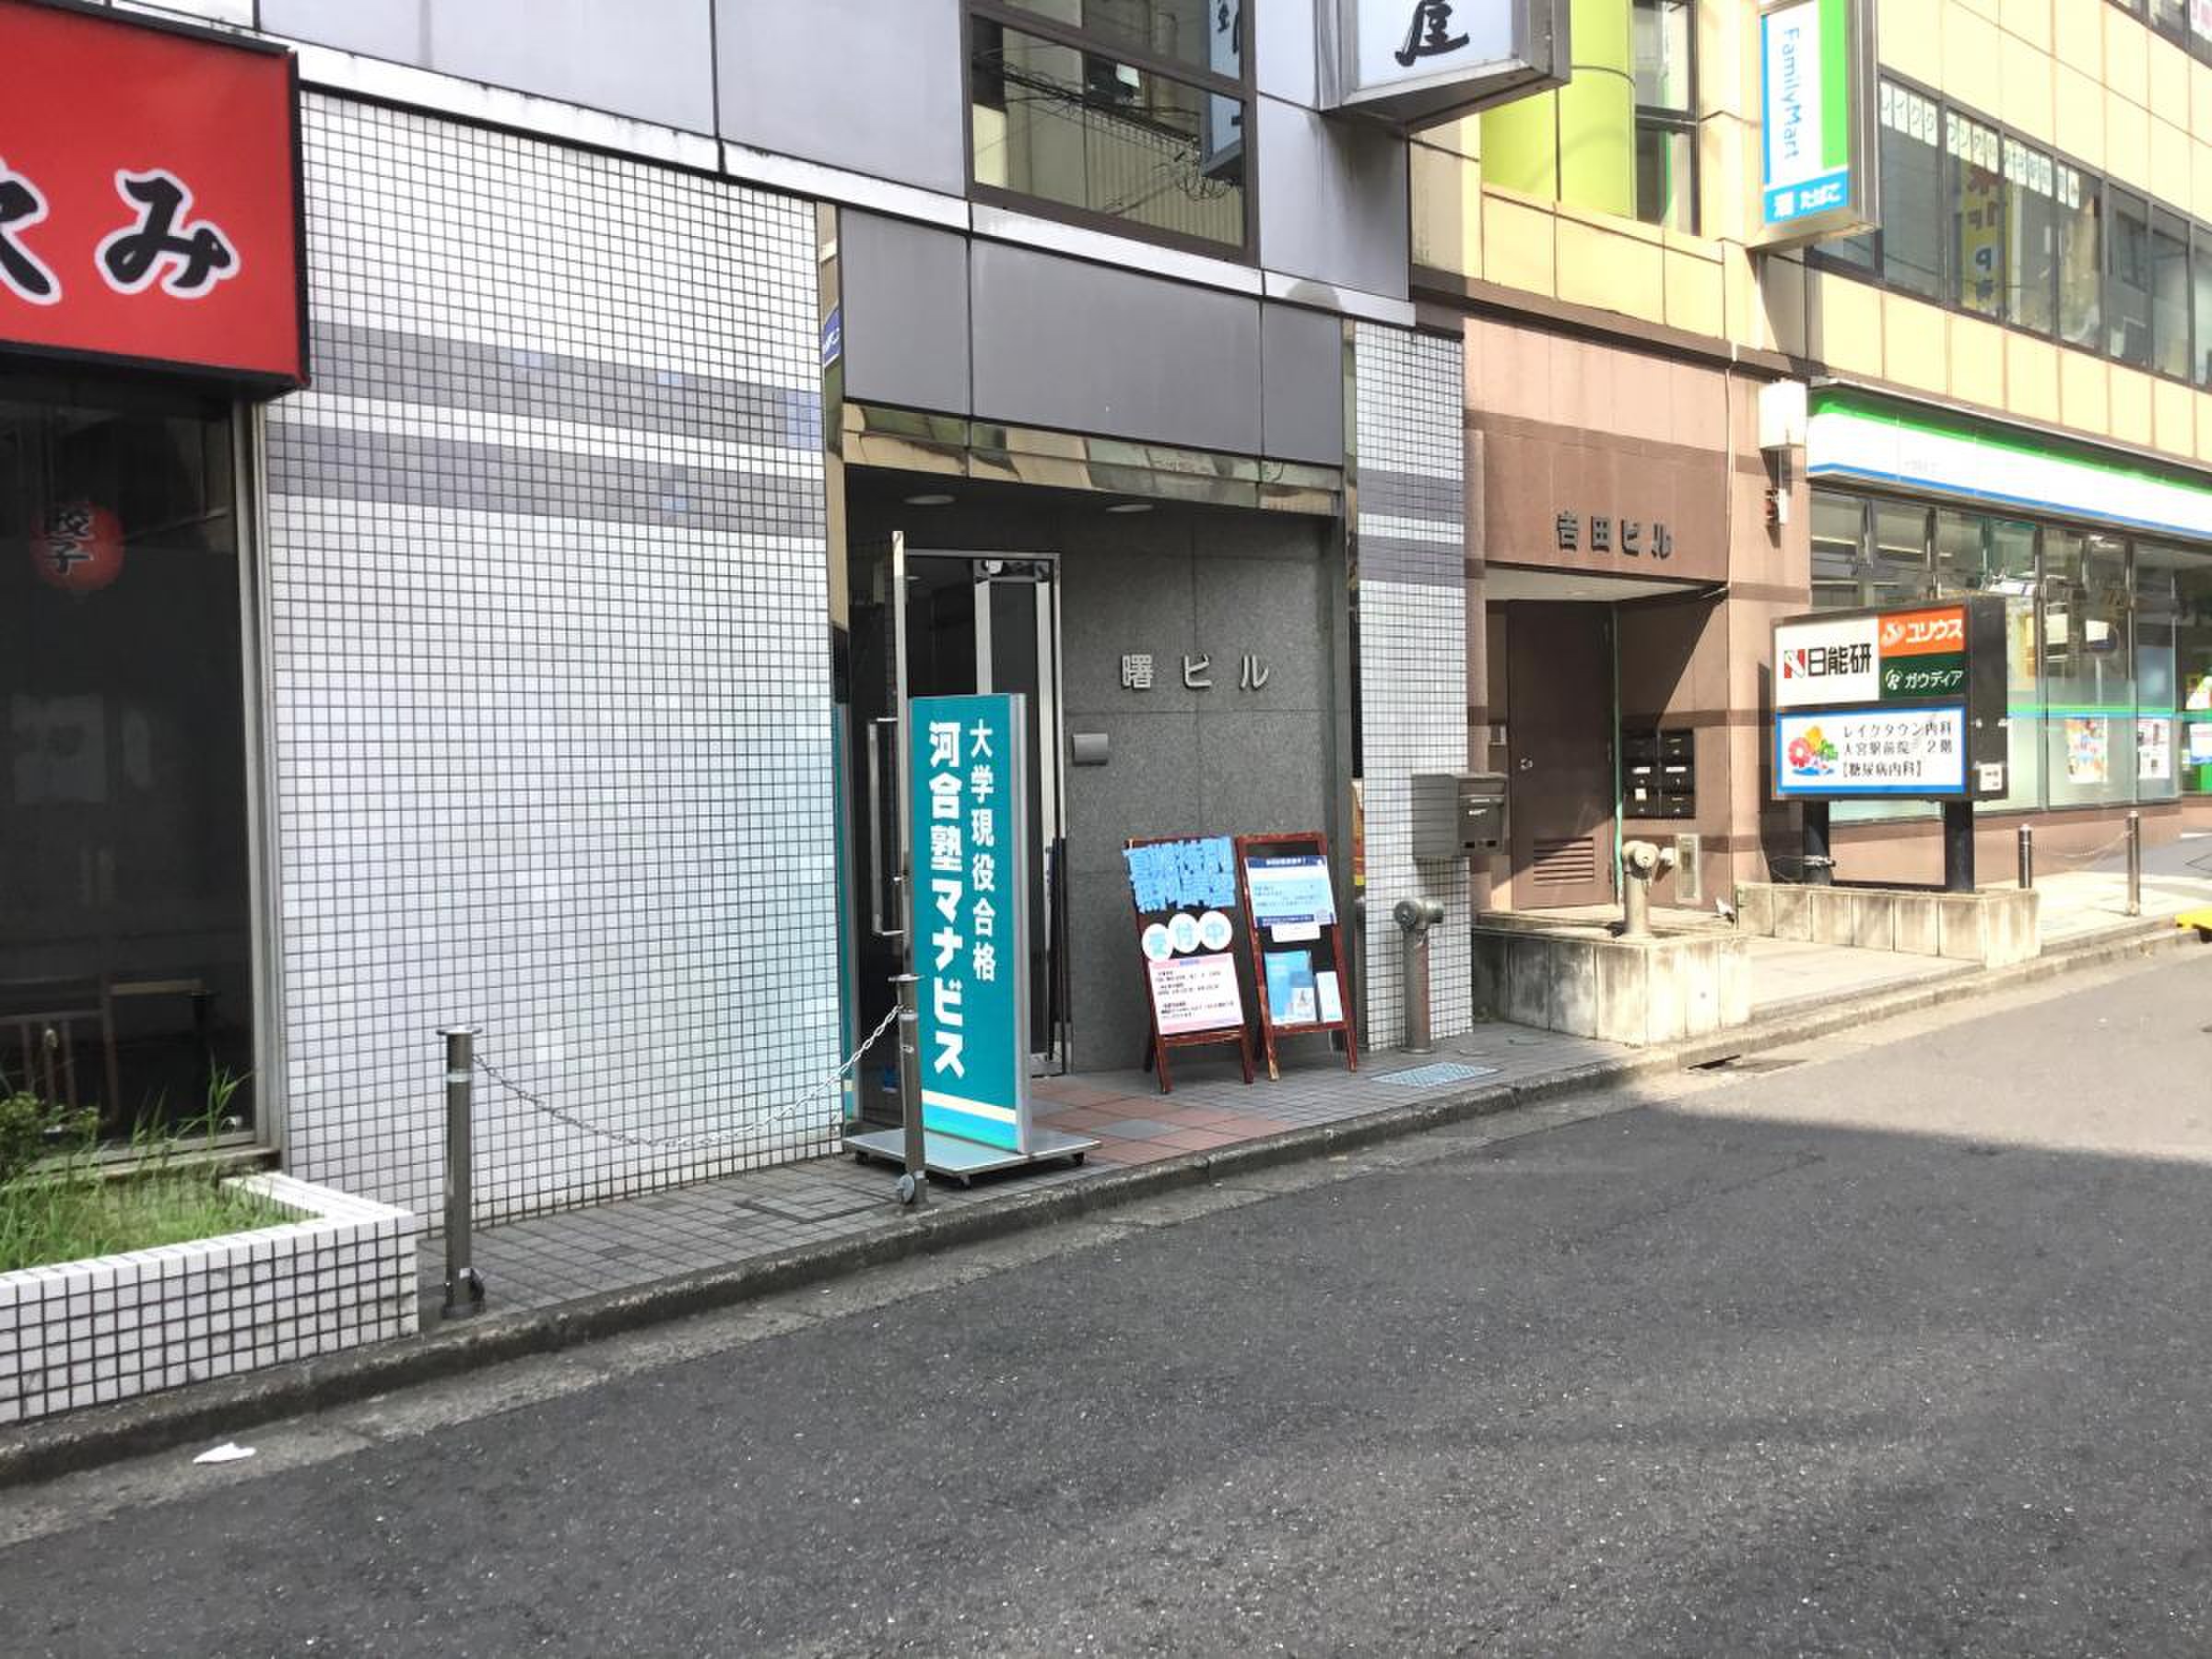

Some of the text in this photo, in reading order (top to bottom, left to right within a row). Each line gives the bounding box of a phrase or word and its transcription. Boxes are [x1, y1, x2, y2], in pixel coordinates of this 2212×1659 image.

[1781, 27, 1803, 160] FamilyMart
[1807, 642, 1872, 677] 日能研
[1905, 618, 1963, 645] ユリウス
[1904, 669, 1964, 690] ガウディア
[970, 718, 996, 982] 大学現役合格
[928, 721, 965, 1079] 河合塾マナビス
